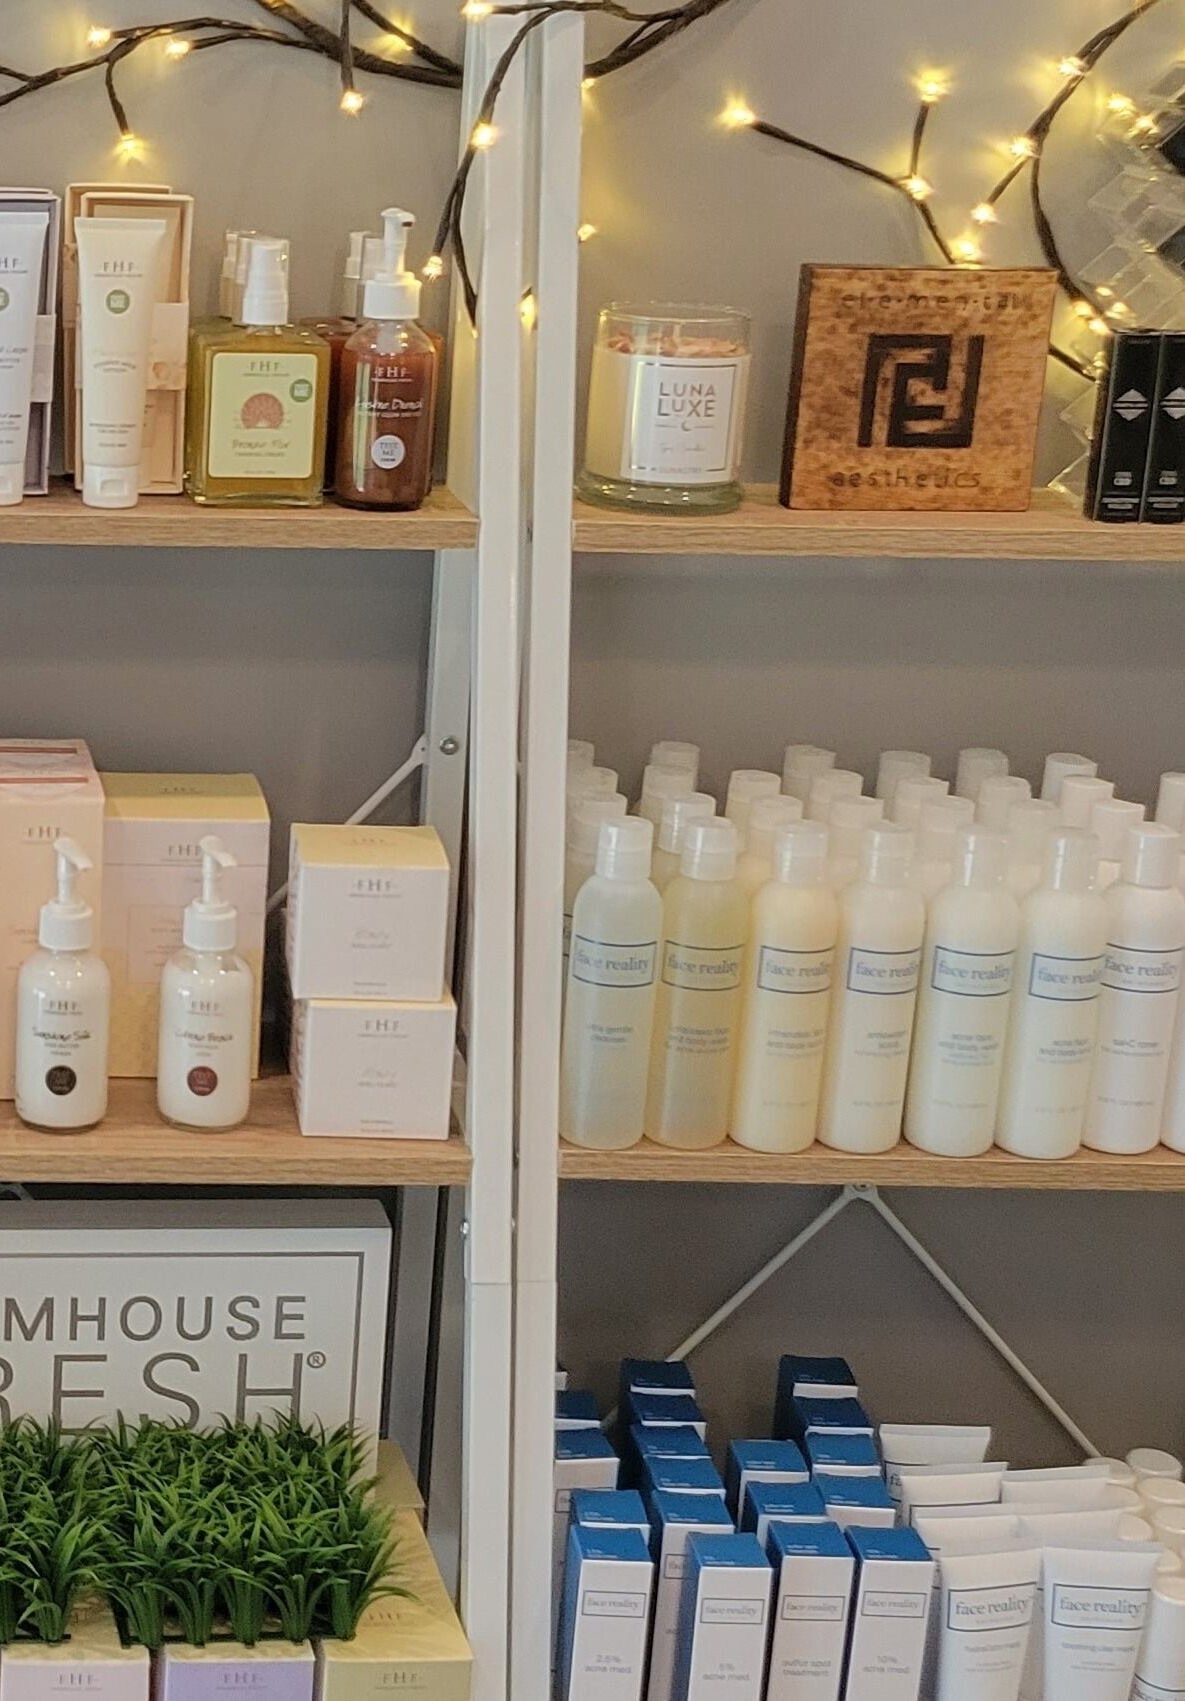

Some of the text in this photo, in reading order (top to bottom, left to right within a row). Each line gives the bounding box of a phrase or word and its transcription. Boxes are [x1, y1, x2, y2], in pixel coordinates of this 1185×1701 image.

[659, 382, 716, 398] LUNA
[657, 398, 717, 418] LUXE
[605, 956, 650, 975] reality
[668, 953, 697, 972] face
[766, 959, 796, 977] face
[856, 961, 888, 978] face
[938, 960, 968, 979] face
[1104, 954, 1134, 973] face
[1038, 969, 1069, 984] face
[955, 1596, 1028, 1617] face reality
[1059, 1596, 1142, 1618] face reality
